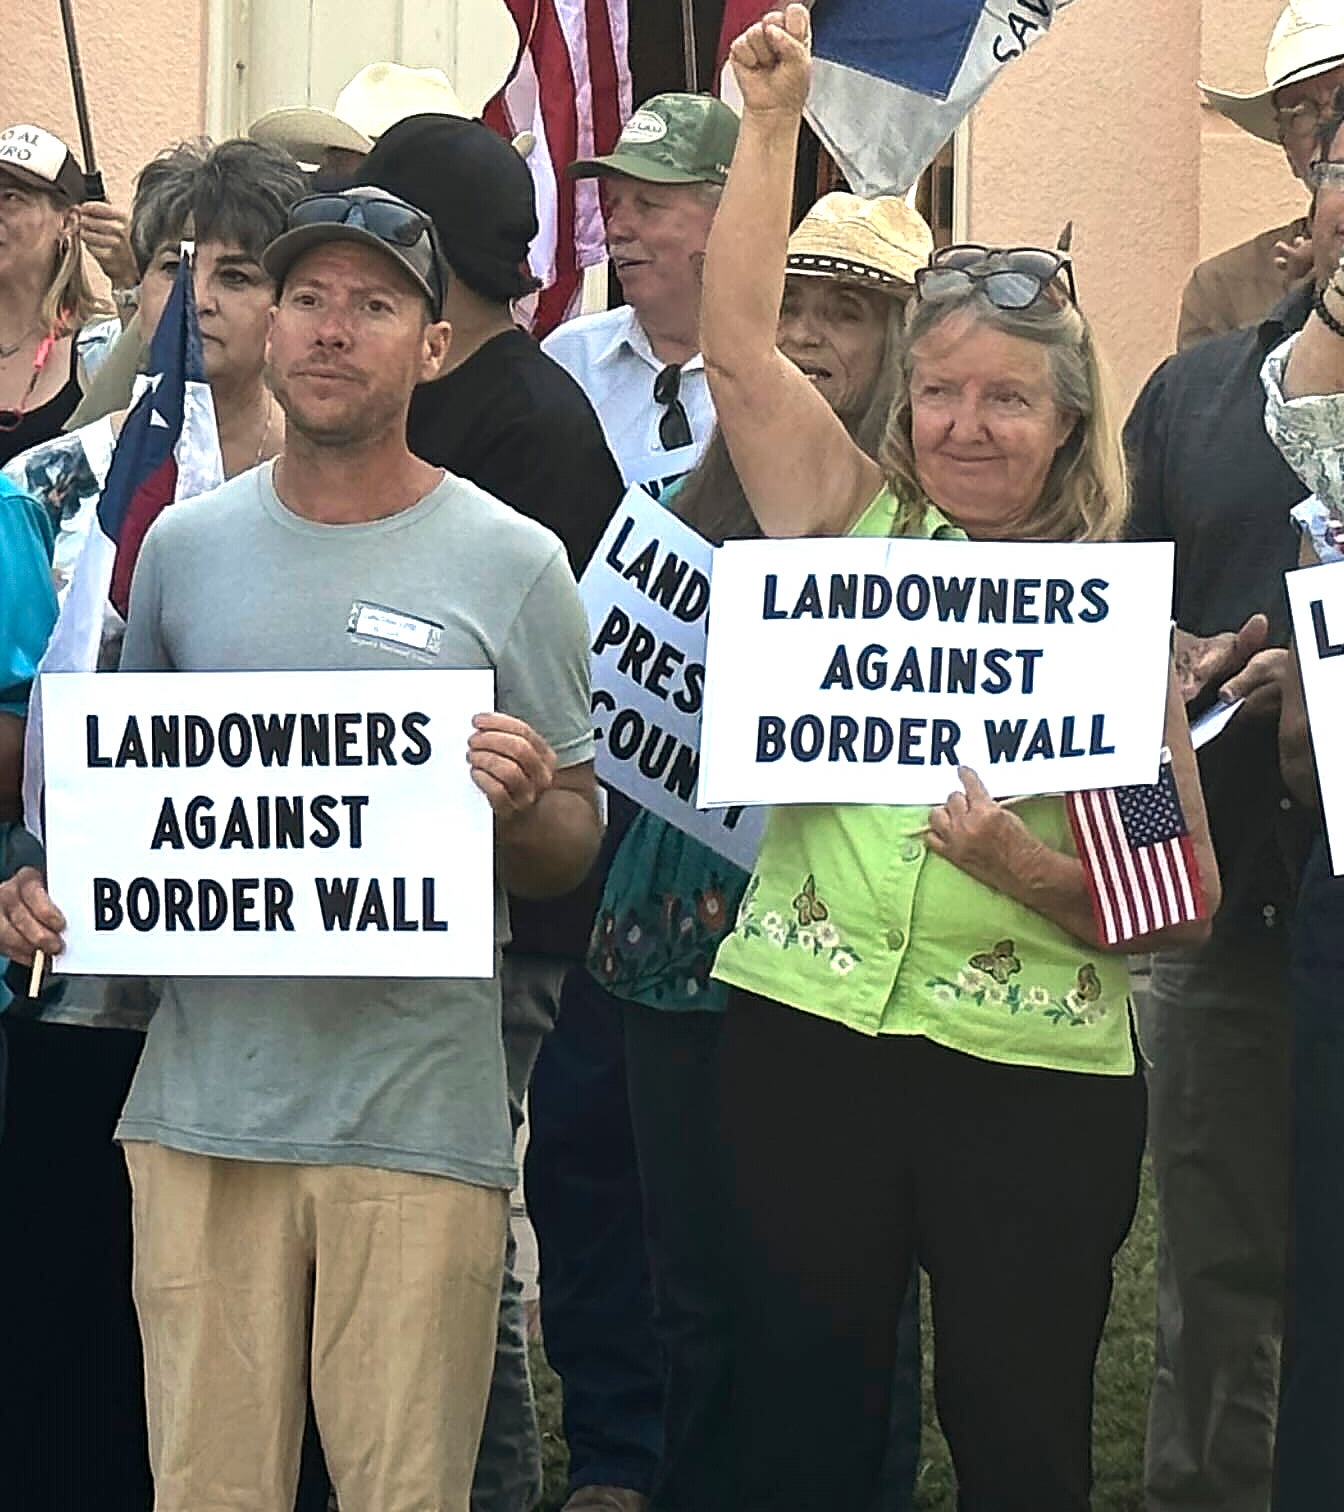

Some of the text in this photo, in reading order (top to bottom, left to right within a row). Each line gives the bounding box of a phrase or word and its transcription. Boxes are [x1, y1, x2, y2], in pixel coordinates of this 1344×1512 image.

[606, 517, 709, 625] LAND
[762, 573, 1109, 624] LANDOWNERS
[819, 644, 1044, 695] AGAINST
[86, 712, 432, 768] LANDOWNERS
[755, 713, 1116, 766] BORDER WALL
[150, 795, 370, 850] AGAINST
[93, 877, 449, 933] BORDER WALL
